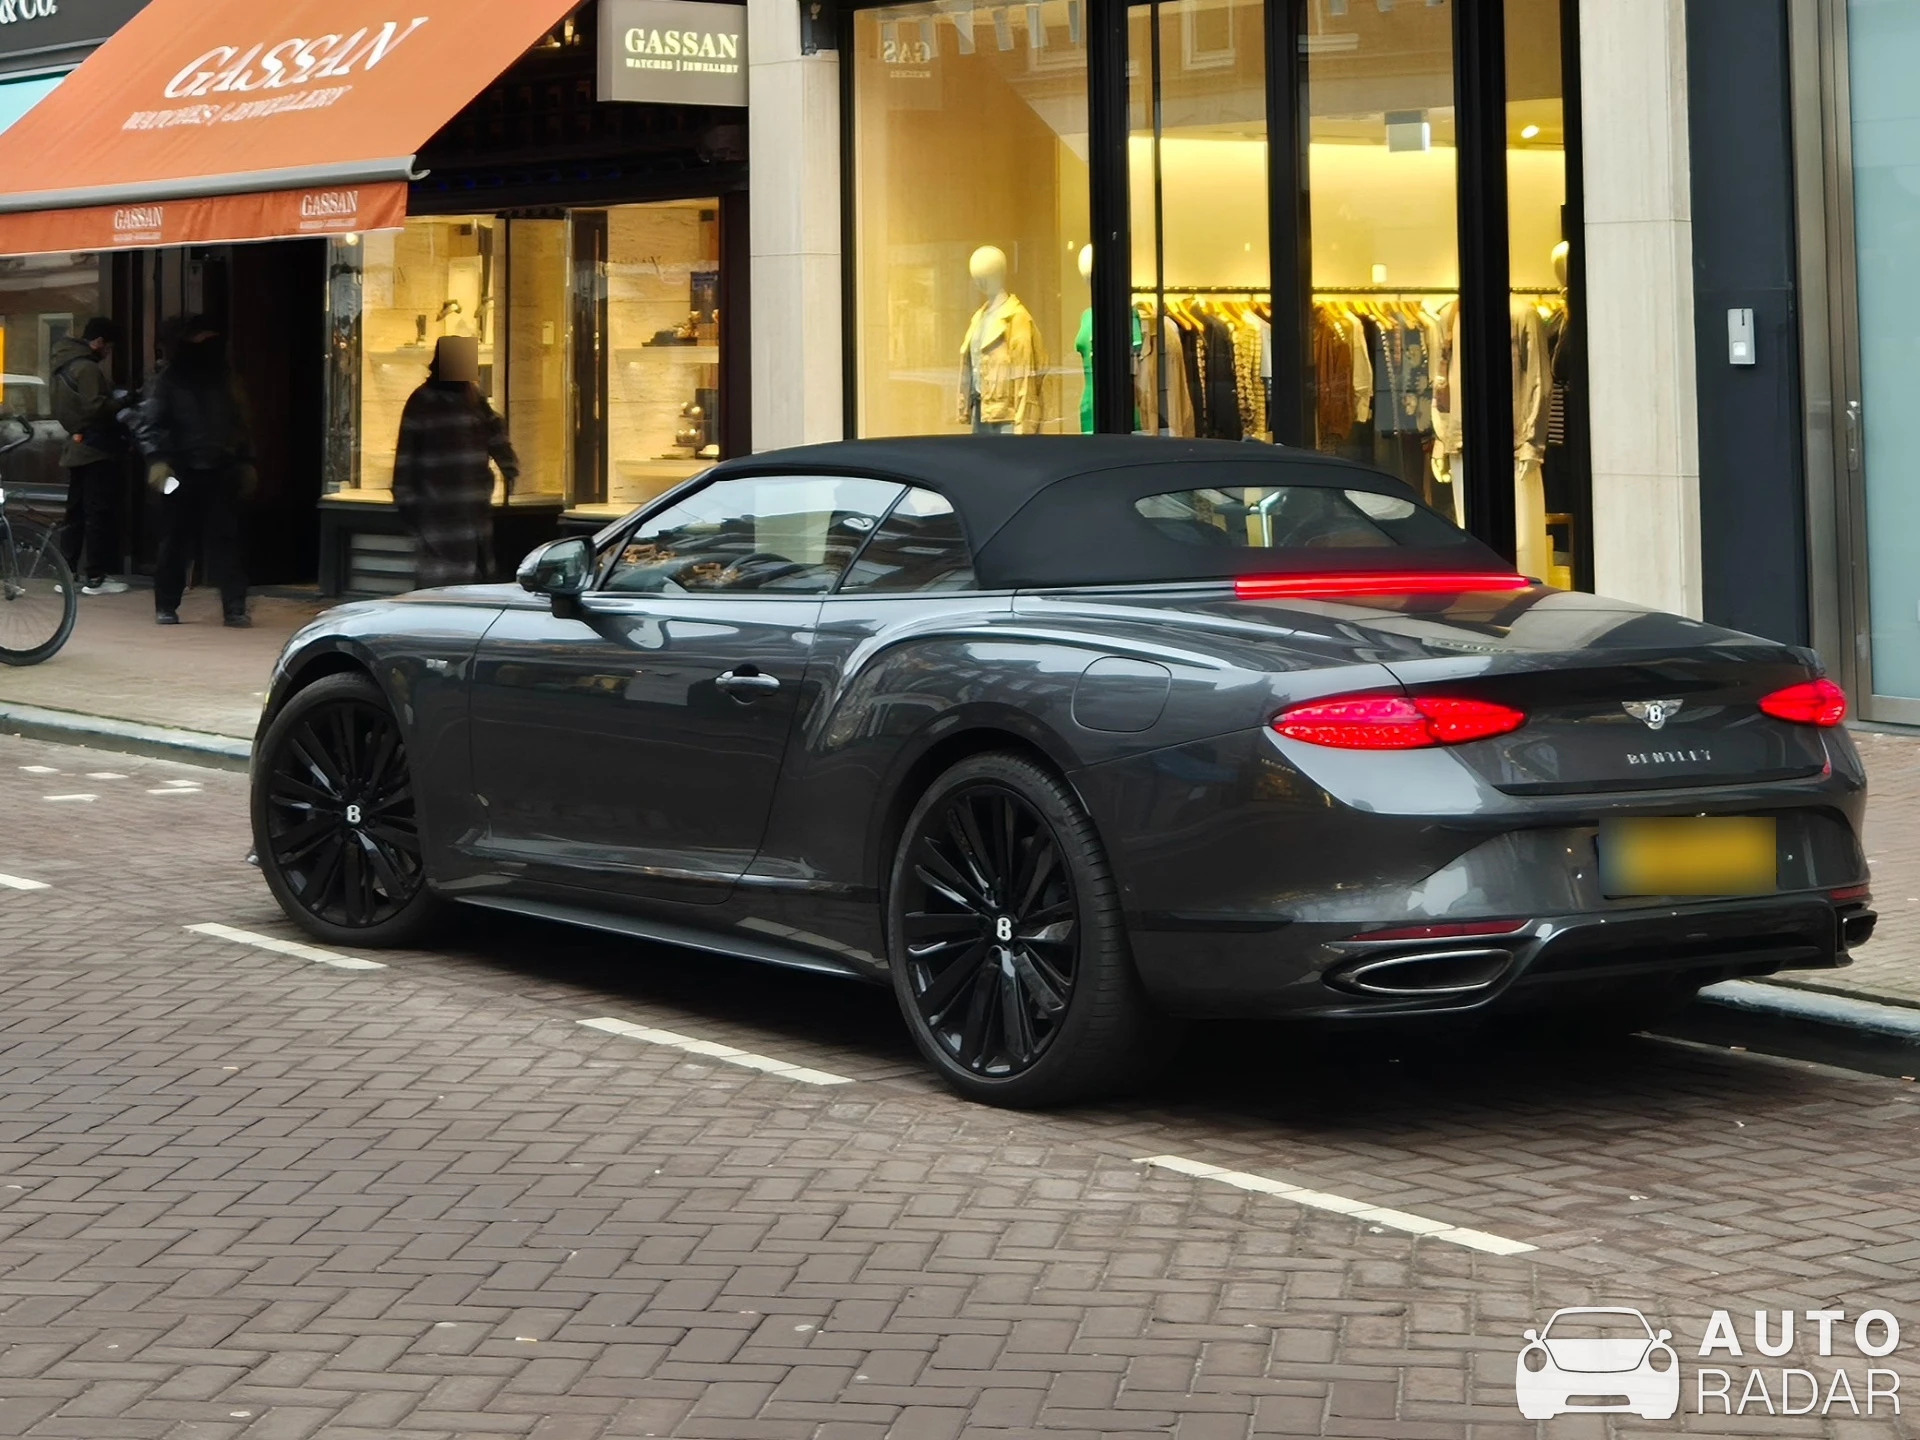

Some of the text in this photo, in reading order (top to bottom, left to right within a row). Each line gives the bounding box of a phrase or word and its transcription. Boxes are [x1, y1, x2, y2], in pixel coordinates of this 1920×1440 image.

[624, 28, 739, 58] GASSAN
[164, 16, 429, 98] GASSAN
[301, 190, 358, 216] GASSAN
[114, 206, 163, 229] GASSAN
[347, 804, 361, 823] B
[997, 917, 1012, 941] B
